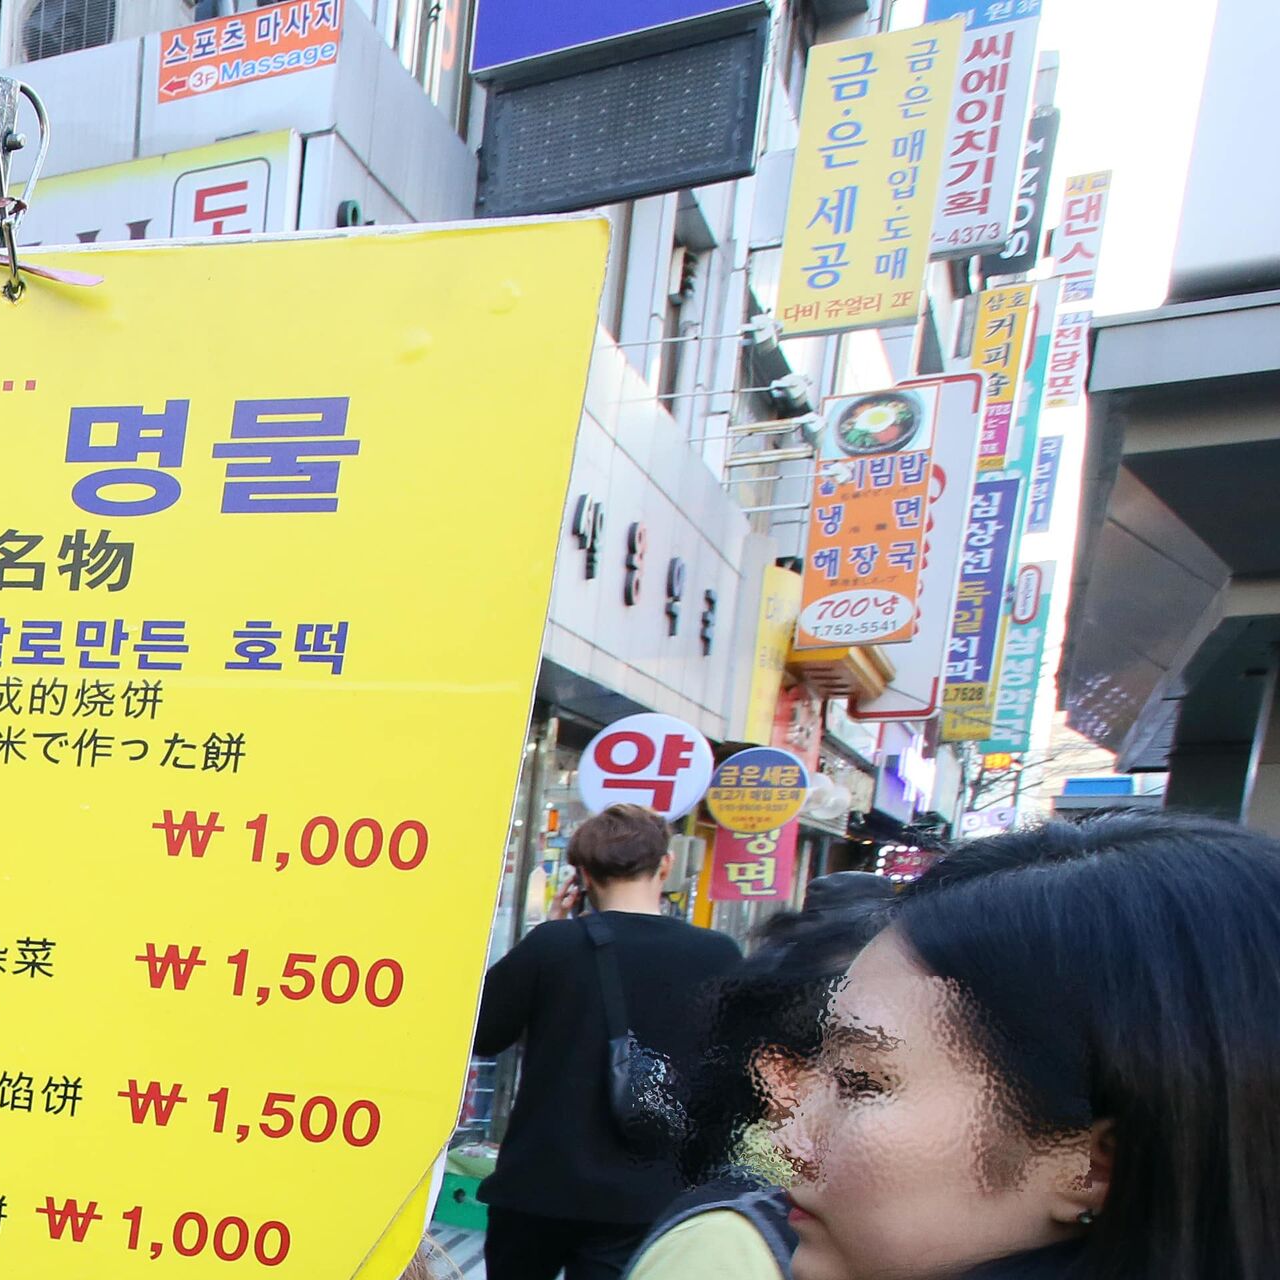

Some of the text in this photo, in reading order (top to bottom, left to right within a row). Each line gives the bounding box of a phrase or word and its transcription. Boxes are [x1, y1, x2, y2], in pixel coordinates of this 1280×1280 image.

[163, 0, 342, 66] 스포츠 마사지
[192, 42, 338, 88] 3F Massage
[942, 30, 1015, 217] 씨에이치기획
[930, 222, 1002, 246] -4373
[824, 293, 883, 320] 쥬얼리
[891, 291, 914, 309] 2F
[62, 396, 362, 517] 명물
[813, 541, 917, 579] 해장국
[811, 619, 898, 638] T.752-5541
[816, 594, 901, 621] 700냥
[225, 617, 350, 678] 호떡
[593, 731, 695, 812] 약
[719, 764, 801, 787] 금은세공
[243, 811, 430, 872] 1,000
[225, 947, 407, 1010] 1,500
[206, 1084, 383, 1148] 1,500
[120, 1205, 293, 1268] 1,000
